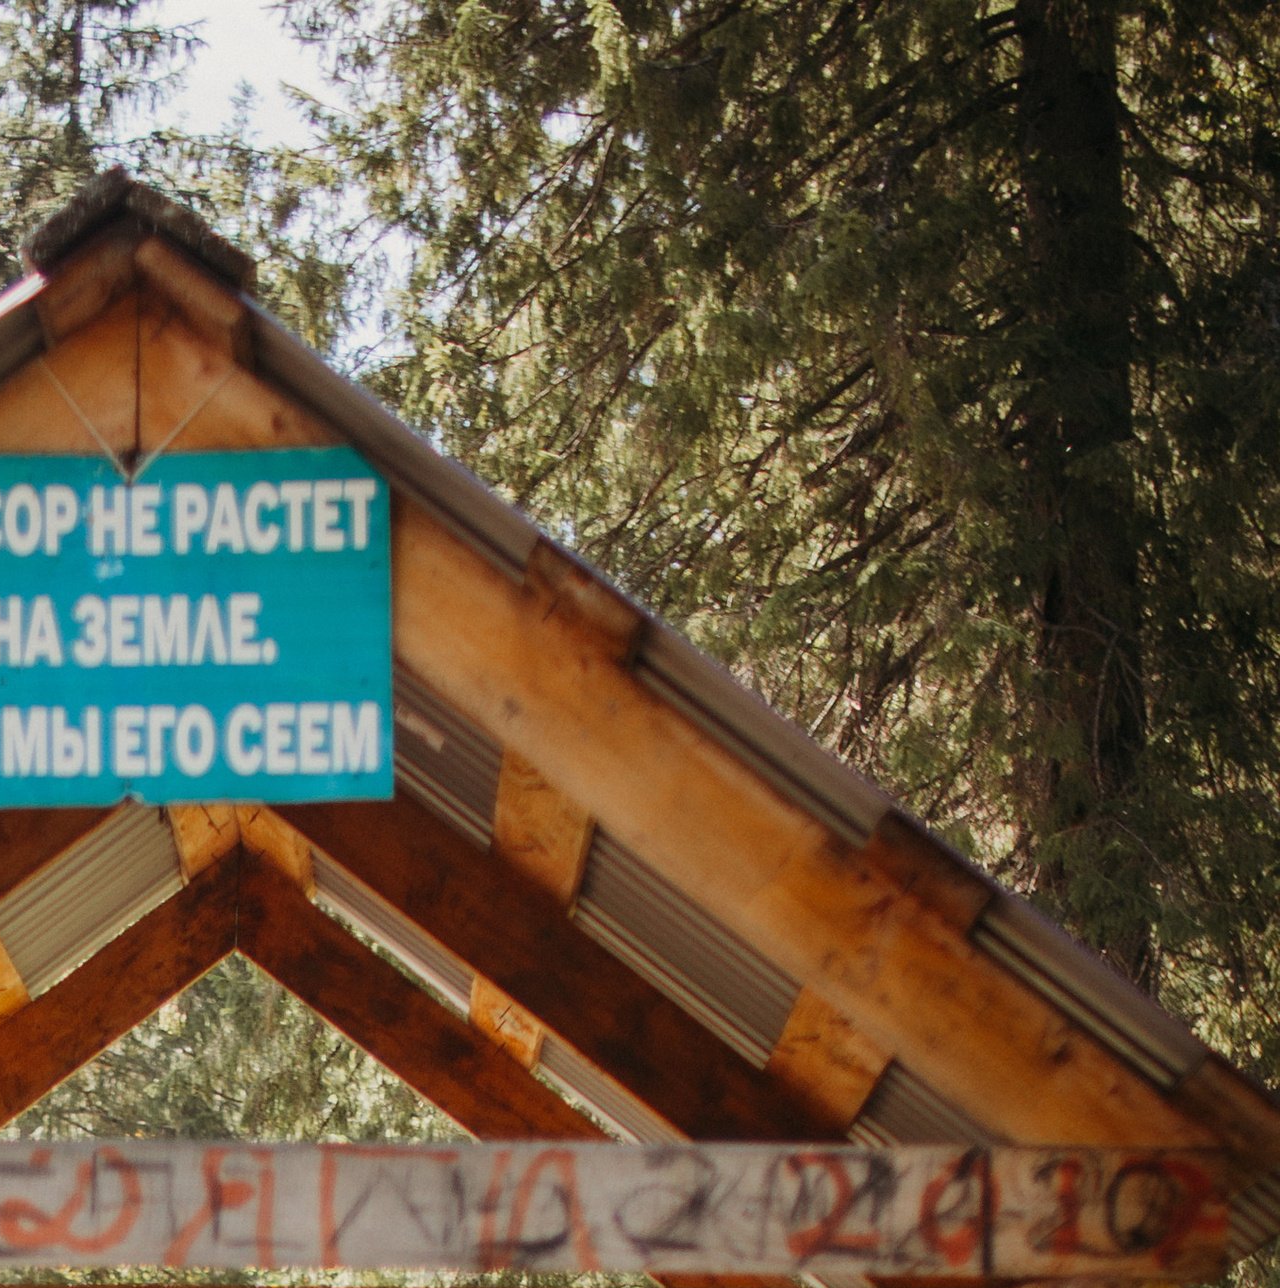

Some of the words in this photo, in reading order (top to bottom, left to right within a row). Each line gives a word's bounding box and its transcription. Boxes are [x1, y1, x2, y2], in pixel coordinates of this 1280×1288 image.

[91, 484, 162, 556] НЕ
[176, 478, 376, 556] РАСТЕТ
[74, 593, 278, 667] ЗЕМЛЕ.
[0, 705, 101, 778] МЫ
[114, 704, 215, 778] ЕГО
[226, 700, 380, 776] СЕЕМ
